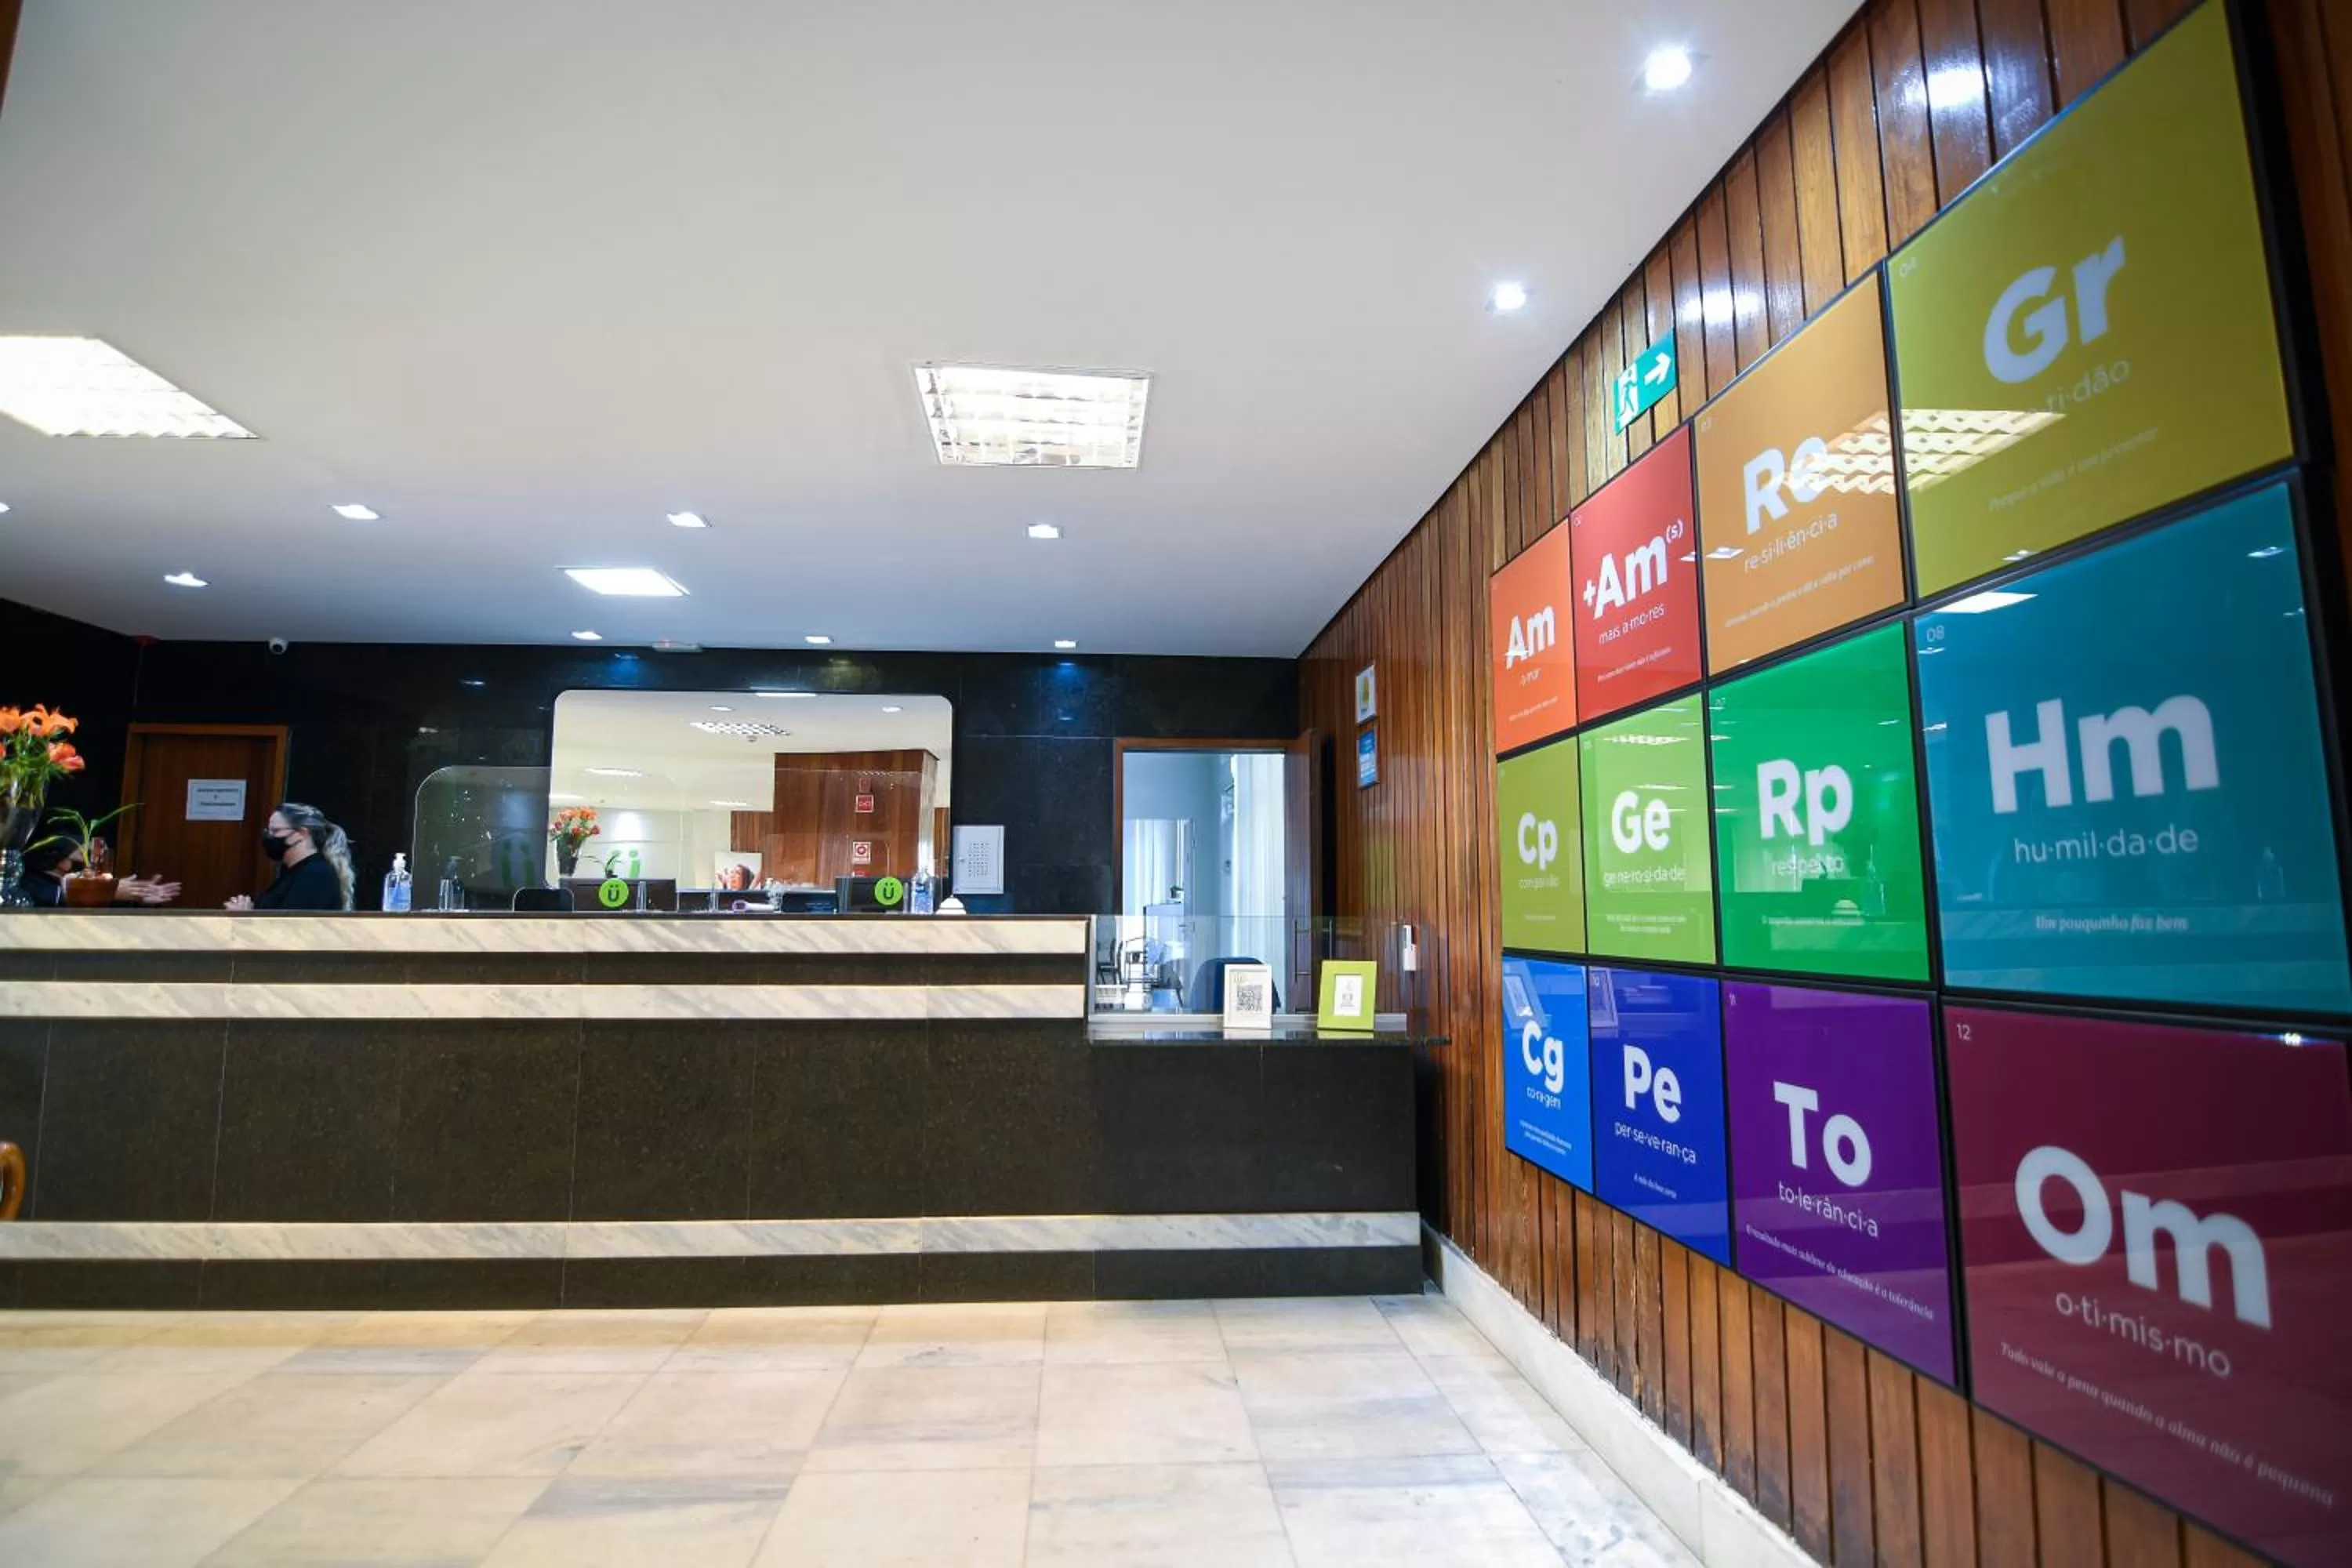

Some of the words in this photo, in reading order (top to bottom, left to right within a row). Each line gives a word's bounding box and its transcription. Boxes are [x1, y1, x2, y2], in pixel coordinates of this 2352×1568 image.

[1983, 234, 2127, 384] Gr
[1505, 604, 1555, 670] Am
[1926, 625, 1945, 643] 08
[1984, 695, 2220, 815] Hm
[1611, 790, 1671, 854] Ge
[1756, 758, 1853, 847] Rp
[1518, 812, 1559, 871] Cp
[1522, 1021, 1563, 1094] Cg
[1956, 1022, 1971, 1041] 12
[1623, 1044, 1682, 1124] Pe
[1773, 1080, 1873, 1188] To
[2014, 1145, 2273, 1330] Om
